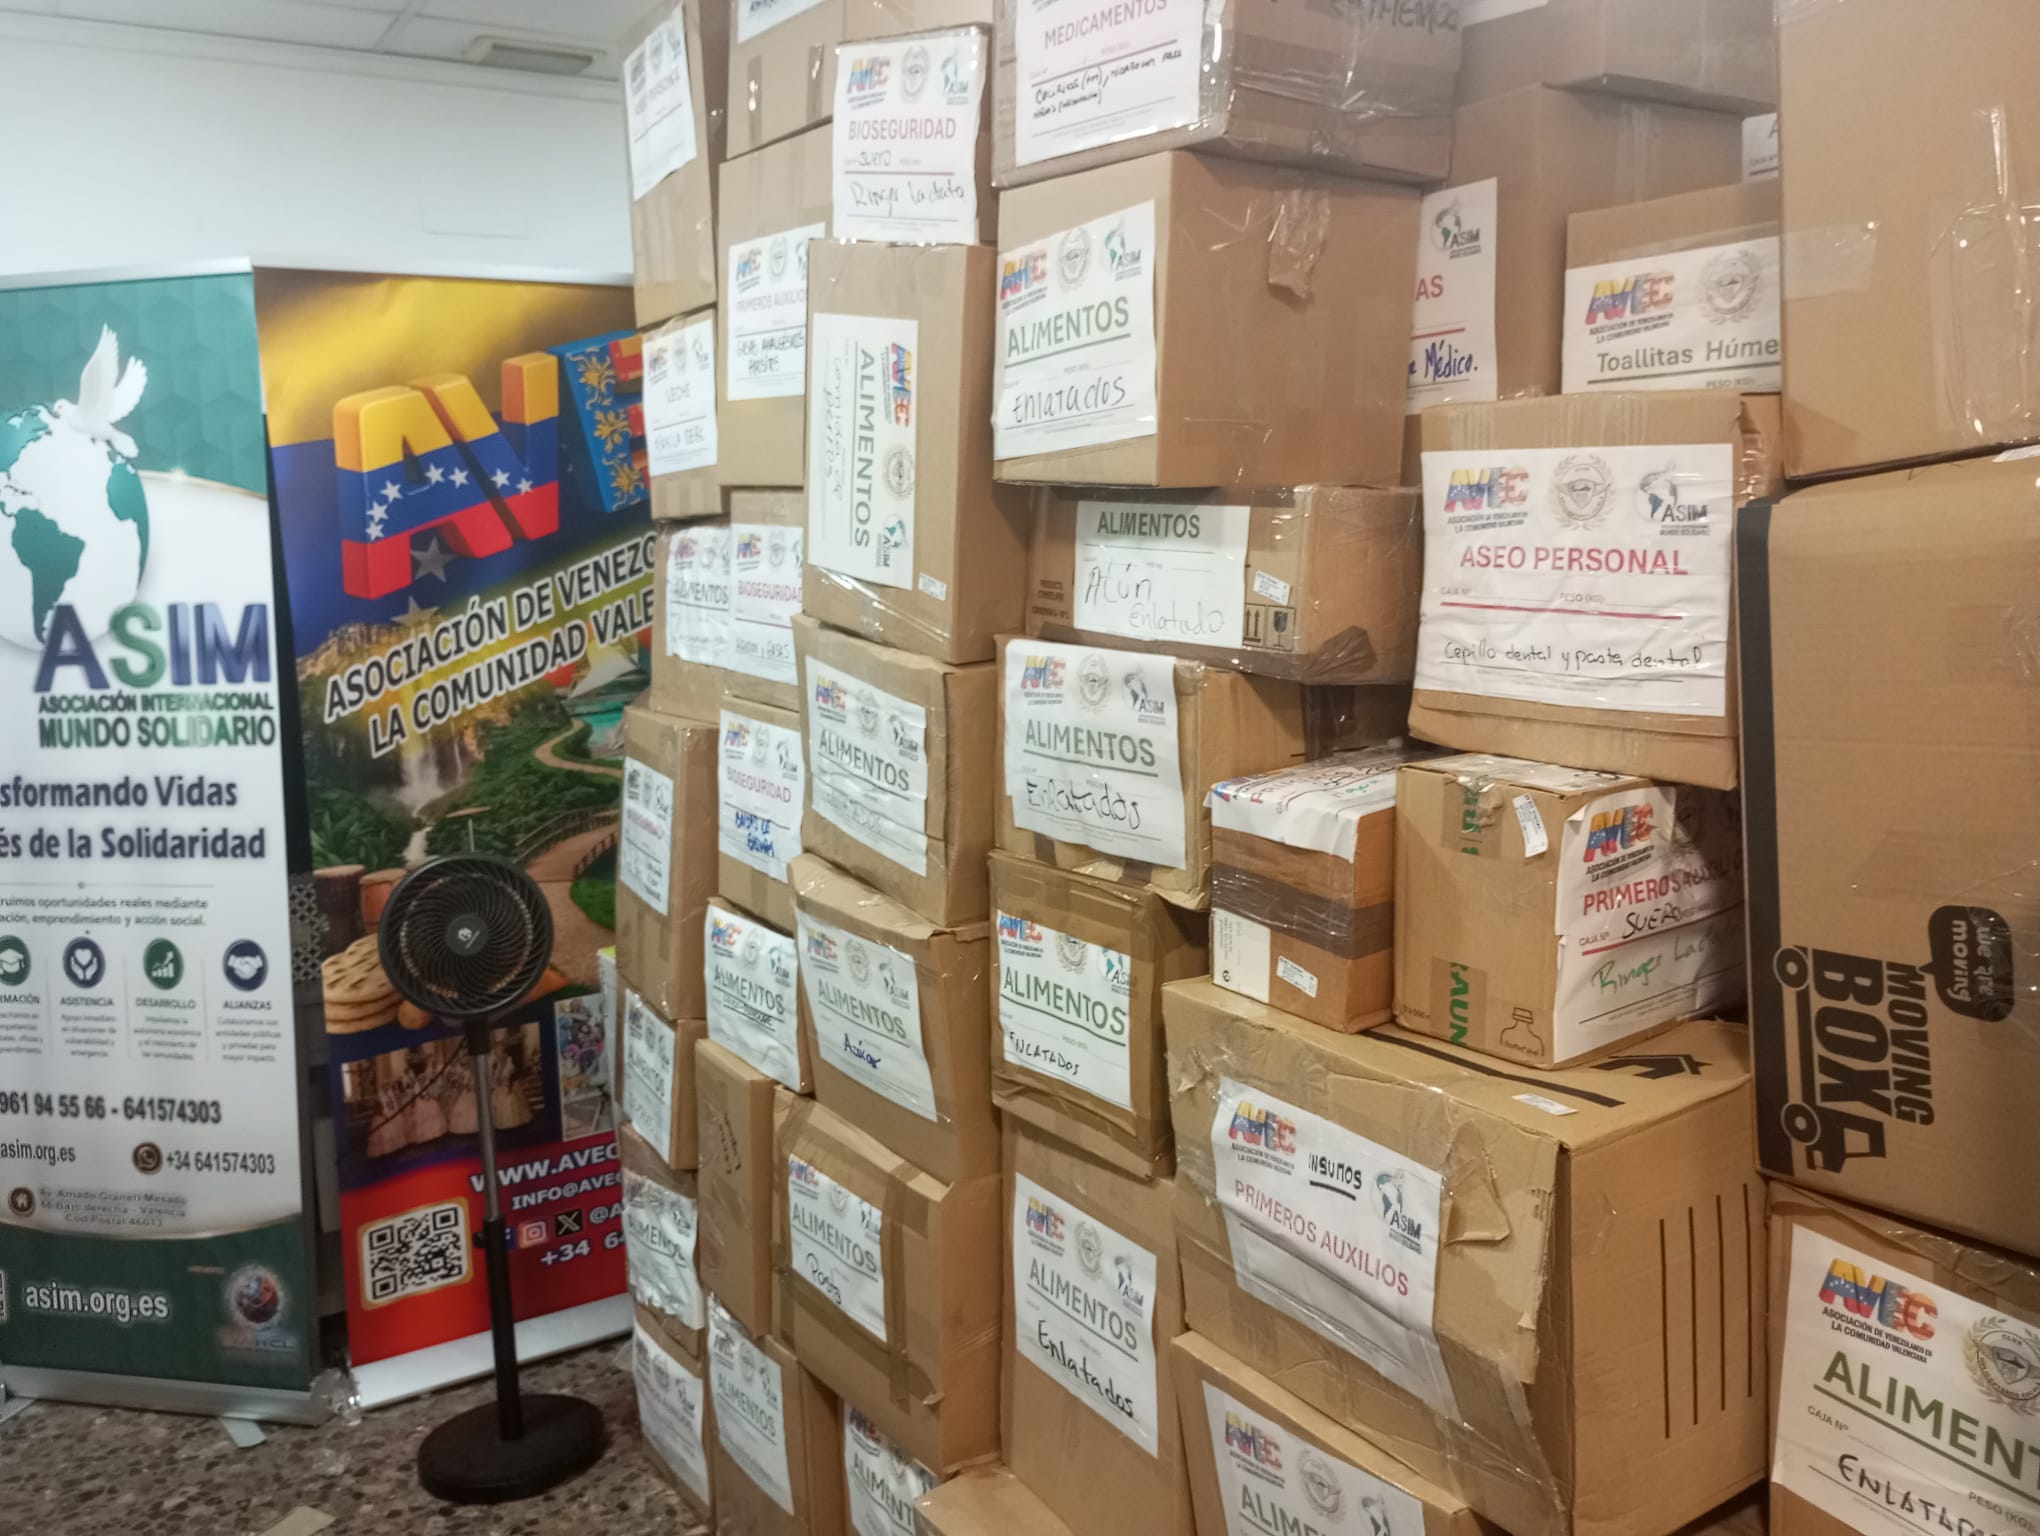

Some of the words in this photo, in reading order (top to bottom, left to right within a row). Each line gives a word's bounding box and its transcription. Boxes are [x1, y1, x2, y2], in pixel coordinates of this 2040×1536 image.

[848, 118, 956, 141] BIOSEGURIDAD
[1451, 228, 1480, 249] ASIM
[1415, 274, 1445, 302] AS
[1007, 296, 1130, 358] ALIMENTOS
[1424, 339, 1479, 383] Médico.
[1597, 345, 1694, 374] Toallitas
[1705, 335, 1779, 362] Húme
[854, 348, 876, 549] ALIMENTOS
[1097, 511, 1201, 539] ALIMENTOS
[1661, 502, 1709, 523] ASIM
[1460, 545, 1526, 569] ASEO
[1533, 547, 1689, 576] PERSONAL
[34, 603, 271, 692] ASIM
[325, 595, 508, 724] ASOCIACIÓN
[513, 580, 553, 629] DE
[1444, 638, 1496, 664] Cepillo
[1505, 645, 1552, 662] dental
[1561, 651, 1571, 671] y
[38, 690, 138, 714] ASOCIACIÓN
[141, 692, 275, 712] INTERNACIONAL
[368, 706, 405, 758] LA
[411, 622, 587, 734] COMUNIDAD
[1139, 699, 1165, 715] ASIM
[39, 716, 131, 748] MUNDO
[137, 715, 276, 748] SOLIDARIO
[1025, 719, 1156, 768] ALIMENTOS
[819, 727, 910, 792] ALIMENTOS
[0, 776, 148, 808] sformando
[154, 776, 238, 807] Vidas
[726, 765, 792, 804] BIOSEGURIDAD
[29, 828, 60, 859] de
[68, 828, 92, 859] la
[101, 827, 267, 860] Solidaridad
[1583, 868, 1681, 916] PRIMEROS
[1622, 902, 1681, 939] SUERO
[1946, 919, 1972, 1002] moving
[1976, 926, 1993, 957] we
[713, 963, 785, 1015] ALIMENTOS
[1974, 963, 1994, 997] are
[222, 1000, 272, 1010] ALIANZAS
[818, 979, 907, 1039] ALIMENTOS
[1004, 966, 1128, 1036] ALIMENTOS
[1812, 948, 1894, 1117] BOX
[1885, 961, 1935, 1126] MOVING
[0, 1092, 28, 1115] 961
[34, 1094, 54, 1117] 94
[59, 1095, 80, 1118] 55
[86, 1096, 106, 1119] 66
[123, 1097, 223, 1124] 641574303
[167, 1150, 190, 1171] +34
[195, 1152, 276, 1175] 641574303
[793, 1203, 878, 1274] ALIMENTOS
[1235, 1178, 1317, 1244] PRIMEROS
[1320, 1229, 1409, 1296] AUXILIOS
[1390, 1210, 1422, 1241] ASIM
[540, 1239, 591, 1265] +34
[26, 1282, 169, 1324] asim.org.es
[1030, 1257, 1138, 1351] ALIMENTOS
[1818, 1258, 1938, 1341] AVEC
[1822, 1306, 1873, 1336] ASOCIACIÓN
[1874, 1327, 1884, 1337] DE
[1831, 1320, 1842, 1332] LA
[1844, 1325, 1891, 1350] COMUNIDAD
[1037, 1320, 1134, 1418] Enlatados
[717, 1374, 777, 1439] ALIMENTOS
[1807, 1404, 1834, 1426] CAJA
[1837, 1453, 1998, 1536] ENLATAD
[1968, 1491, 2003, 1515] PESO
